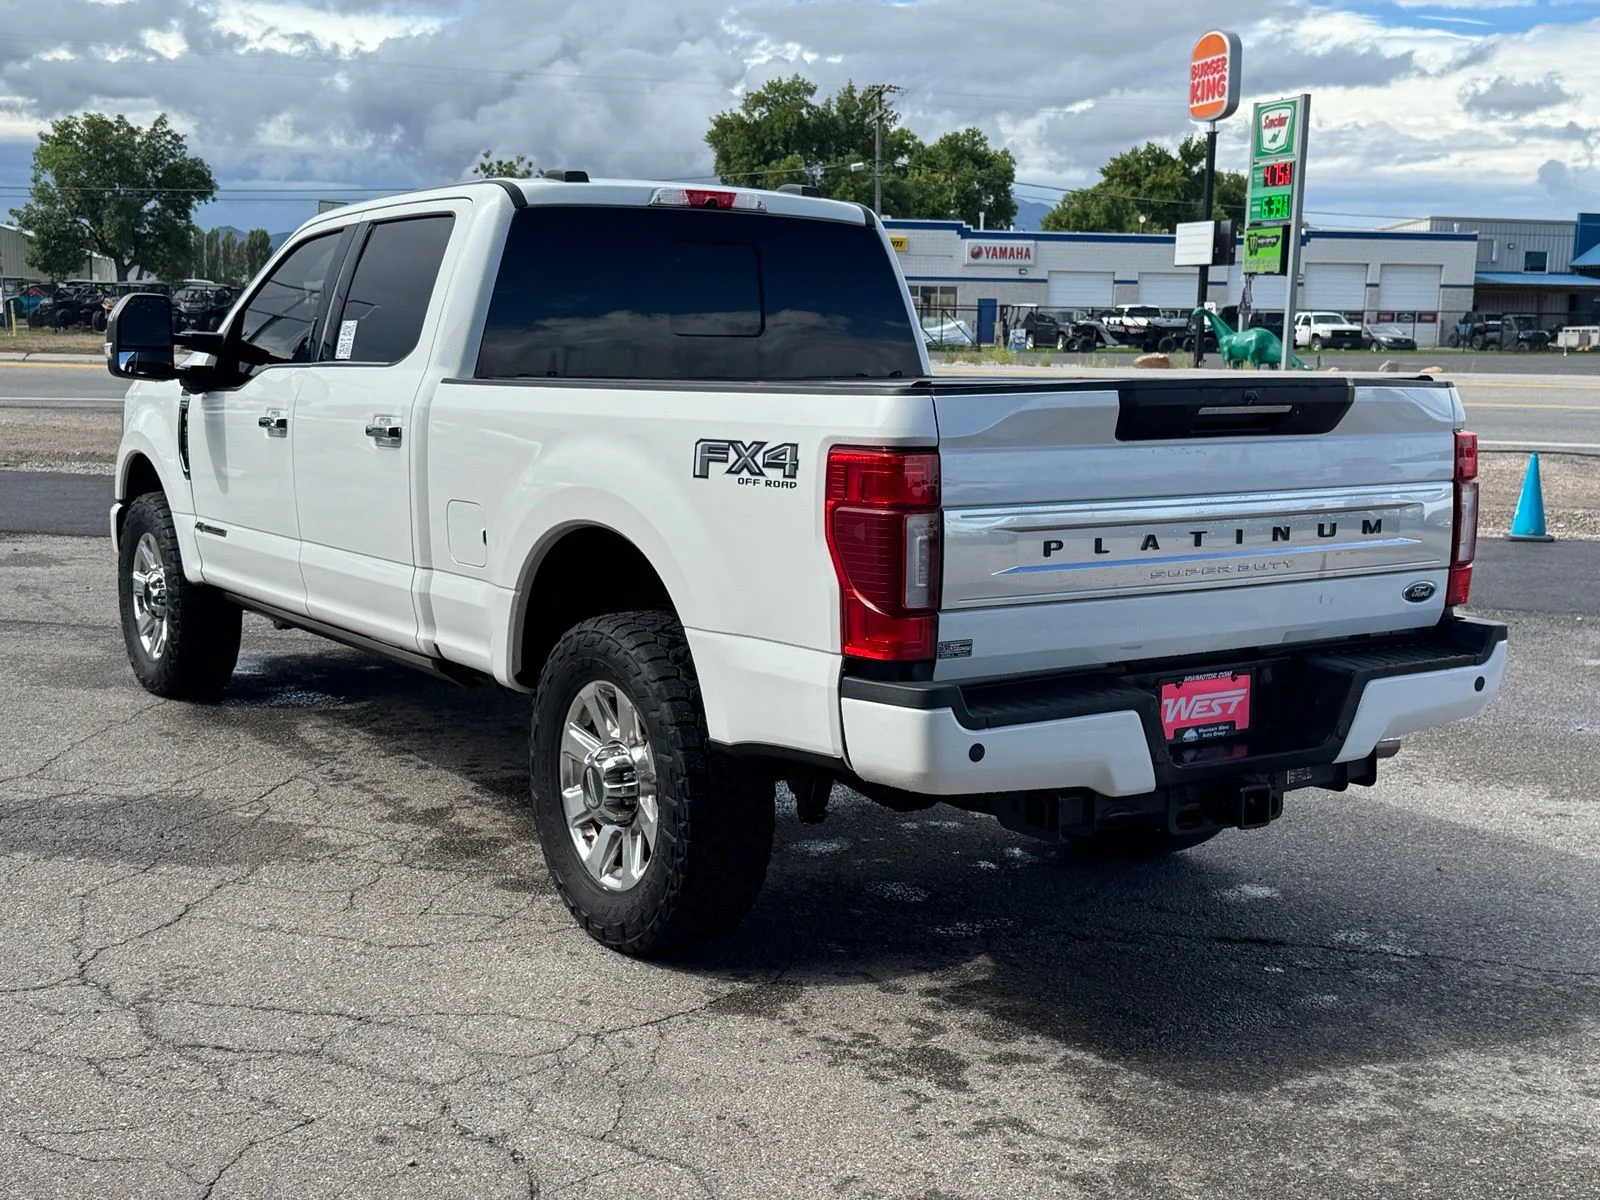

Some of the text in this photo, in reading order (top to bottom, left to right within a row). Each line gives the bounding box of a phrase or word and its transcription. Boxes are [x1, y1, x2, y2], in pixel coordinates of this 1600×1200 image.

[1191, 56, 1227, 80] BURGER
[1190, 74, 1227, 105] KING
[984, 245, 1031, 260] YAMAHA
[693, 438, 799, 479] FX4
[737, 477, 797, 489] OFF ROAD
[1043, 518, 1382, 558] PLATINUM
[1150, 559, 1295, 579] SUPER DUTY
[1183, 670, 1233, 683] MWMOTOR.COM
[1163, 688, 1248, 723] WEST
